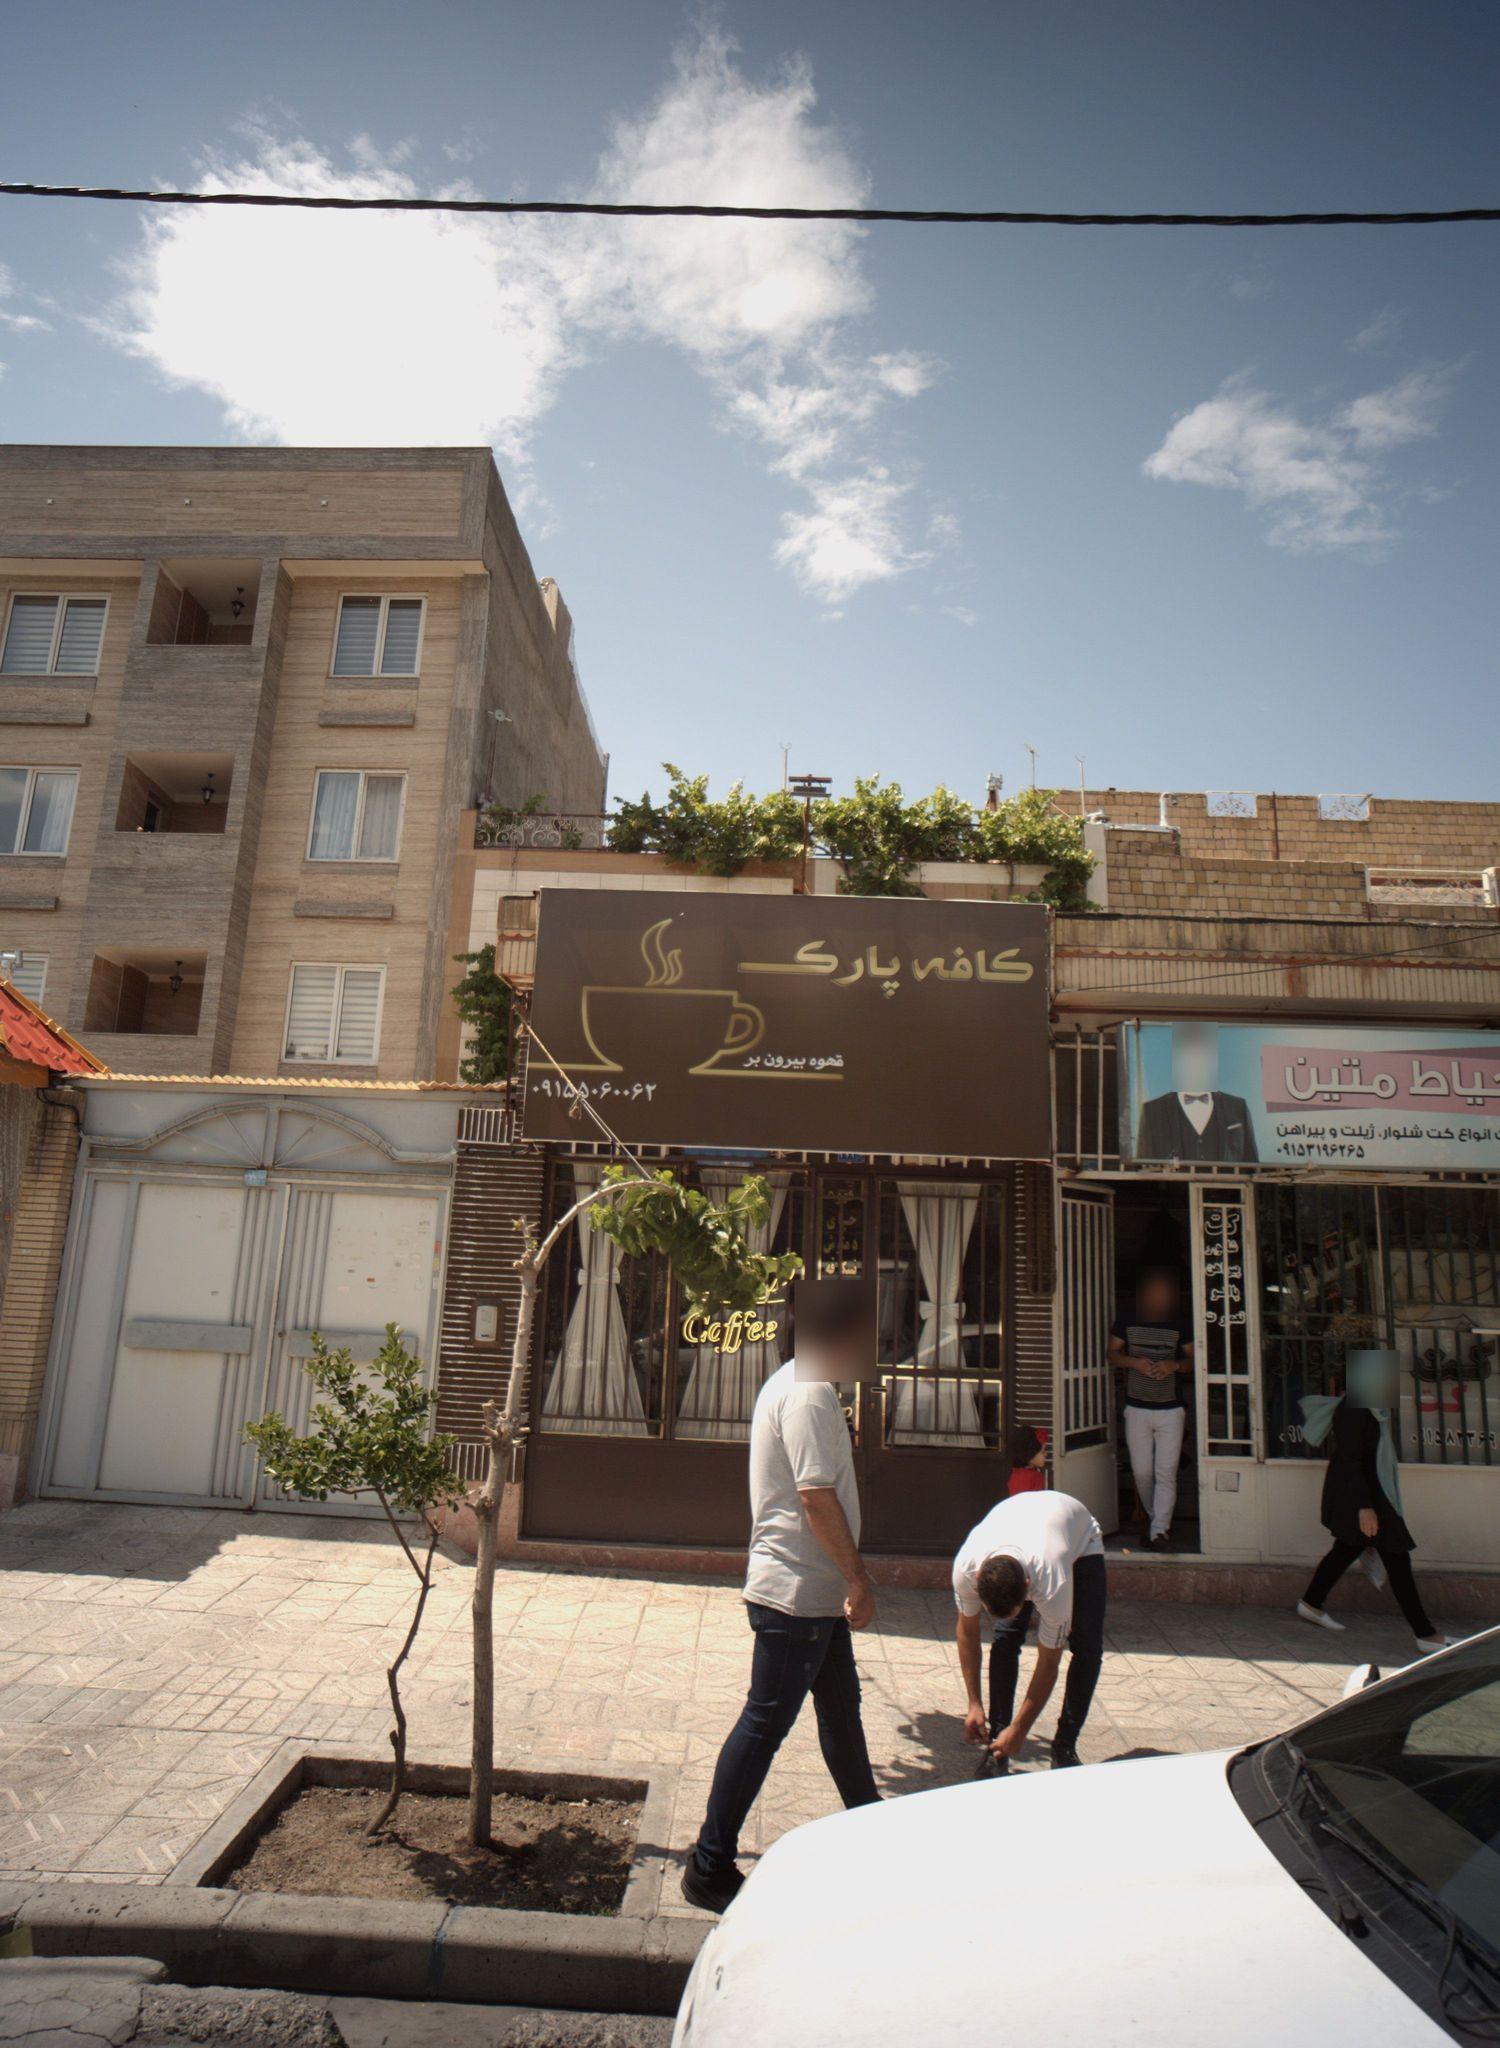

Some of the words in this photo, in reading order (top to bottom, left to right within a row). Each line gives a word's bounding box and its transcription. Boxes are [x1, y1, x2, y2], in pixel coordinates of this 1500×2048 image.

[738, 940, 901, 998] پارک
[913, 947, 1034, 983] کافه
[744, 1054, 761, 1068] بر
[763, 1053, 806, 1069] بیرون
[809, 1054, 845, 1070] قهوه
[1284, 1057, 1397, 1102] متین
[1276, 1123, 1326, 1140] پیراهن
[1329, 1127, 1338, 1139] و
[1341, 1123, 1376, 1140] ژیلت
[1426, 1127, 1455, 1140] کت
[1458, 1128, 1492, 1142] انواع
[1277, 1143, 1366, 1159] ۰۹۱۵۳۱۹۶۲۶۵
[683, 1310, 779, 1355] Coffee
